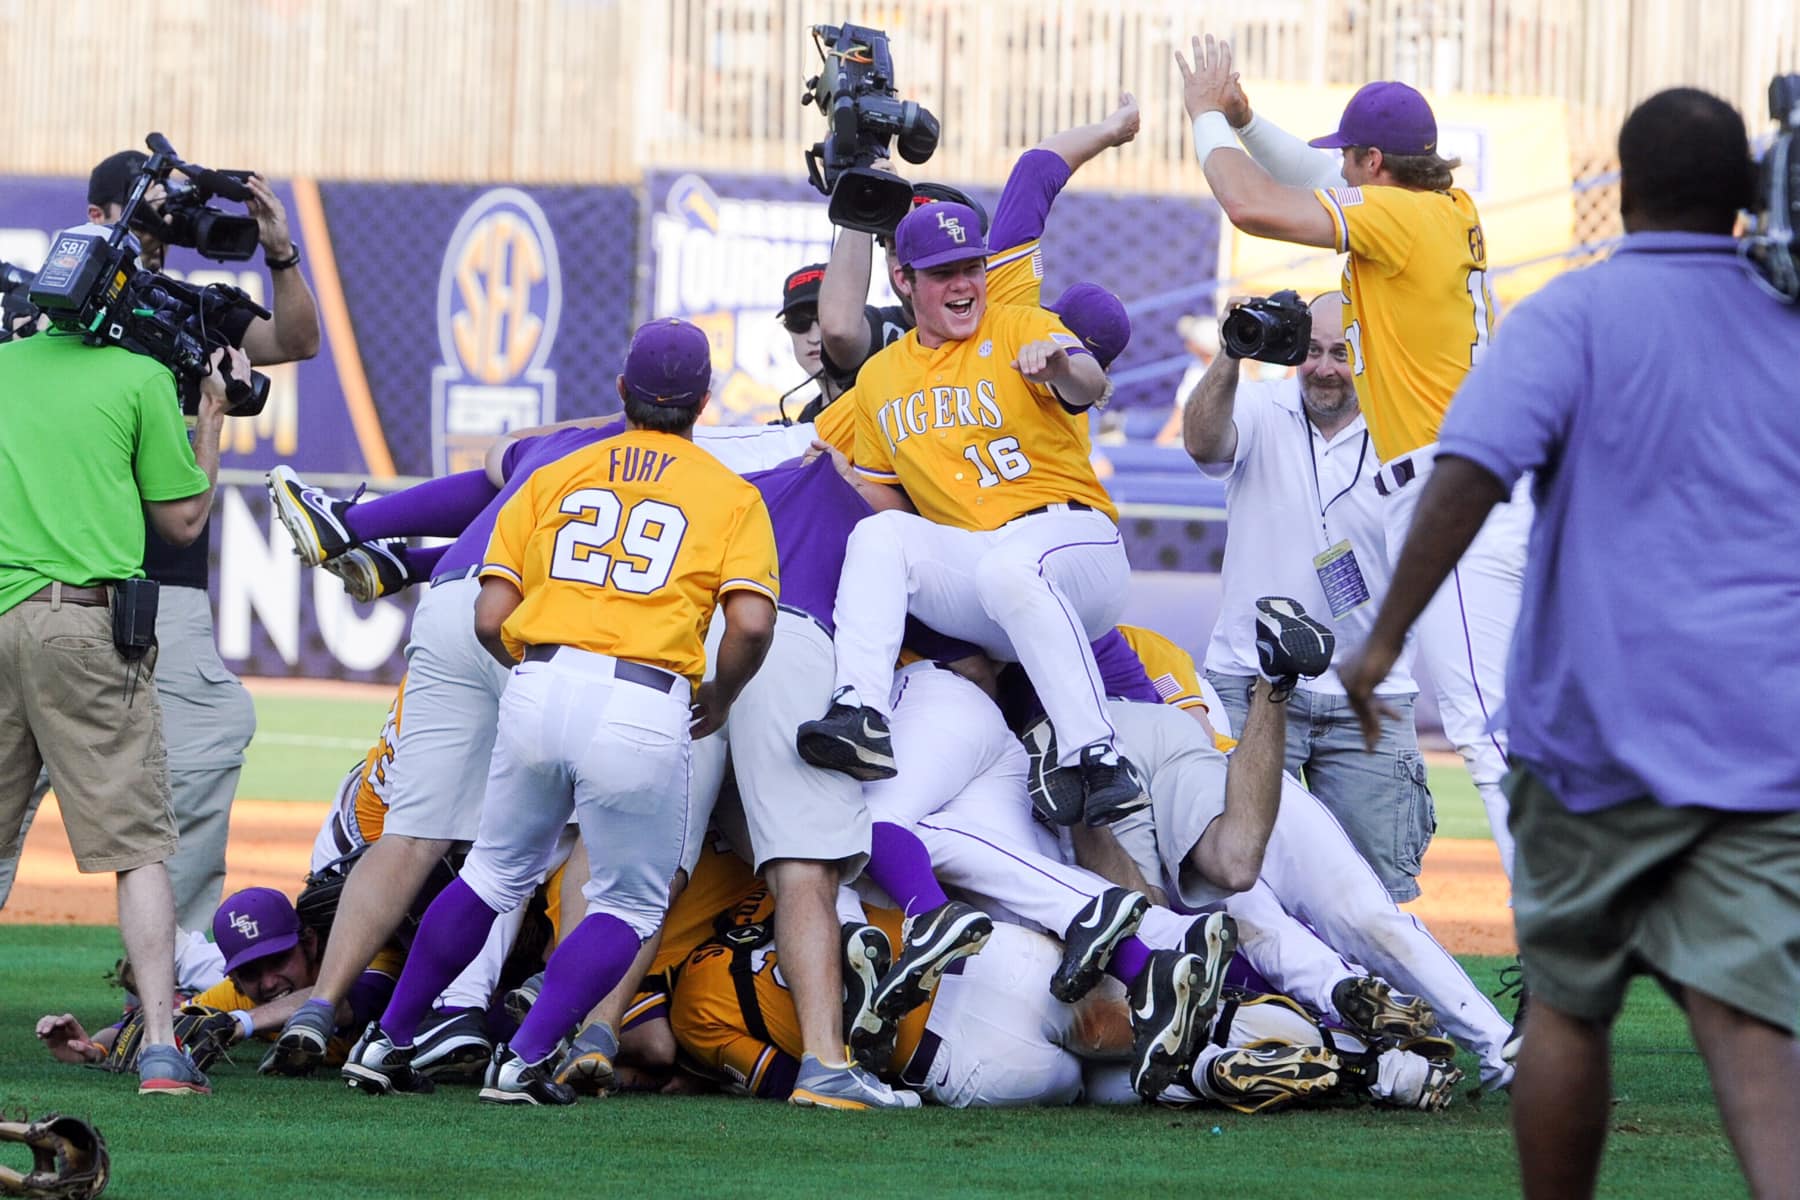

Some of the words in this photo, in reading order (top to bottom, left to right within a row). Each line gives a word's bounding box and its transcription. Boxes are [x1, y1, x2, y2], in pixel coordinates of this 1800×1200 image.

[935, 211, 967, 244] LSU
[58, 240, 85, 257] SBI
[877, 379, 1003, 458] TIGERS
[608, 446, 678, 482] FURY
[963, 435, 1032, 488] 16
[549, 487, 689, 595] 29
[228, 910, 259, 939] LSU
